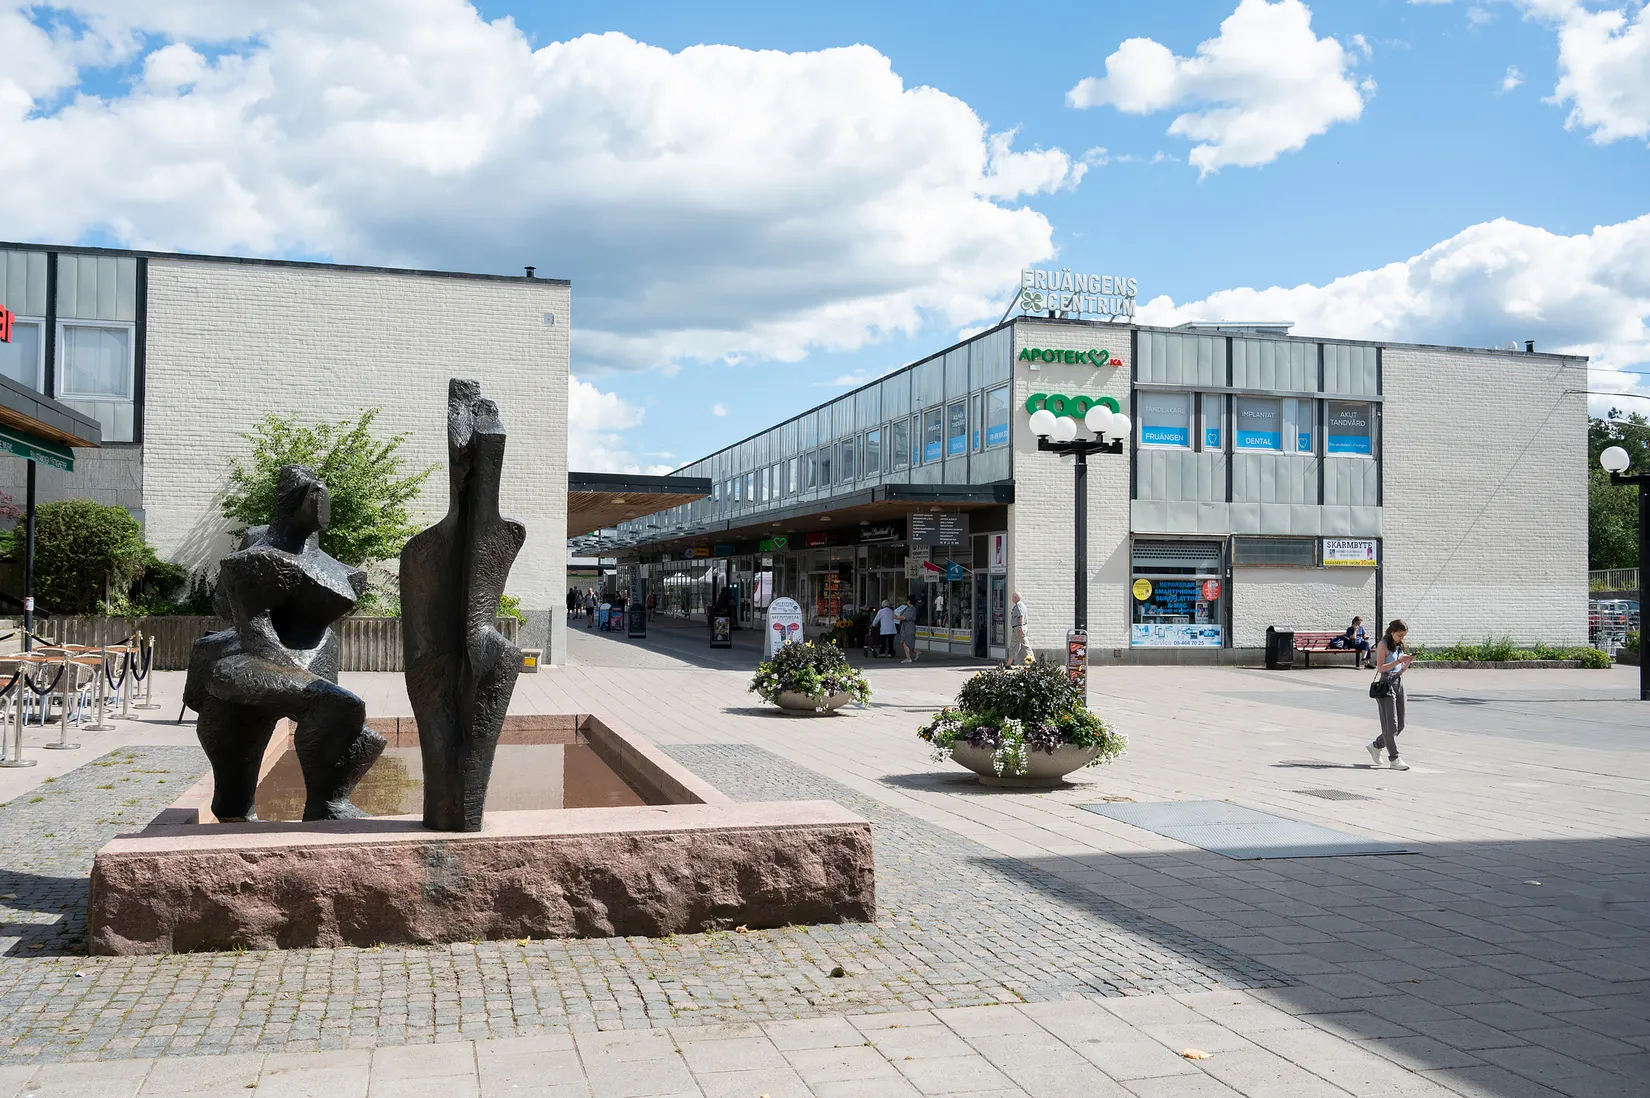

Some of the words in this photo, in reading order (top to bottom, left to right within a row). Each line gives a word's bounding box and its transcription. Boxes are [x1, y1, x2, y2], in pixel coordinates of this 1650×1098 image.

[1021, 268, 1138, 297] FRUÄNGENS
[1046, 293, 1137, 317] CENTRUM
[1019, 347, 1088, 364] APOTEK
[1110, 359, 1123, 367] ICA
[1330, 418, 1366, 427] TANDVÅRD
[1145, 432, 1184, 441] FRUÄNGEN
[1245, 437, 1272, 445] DENTAL
